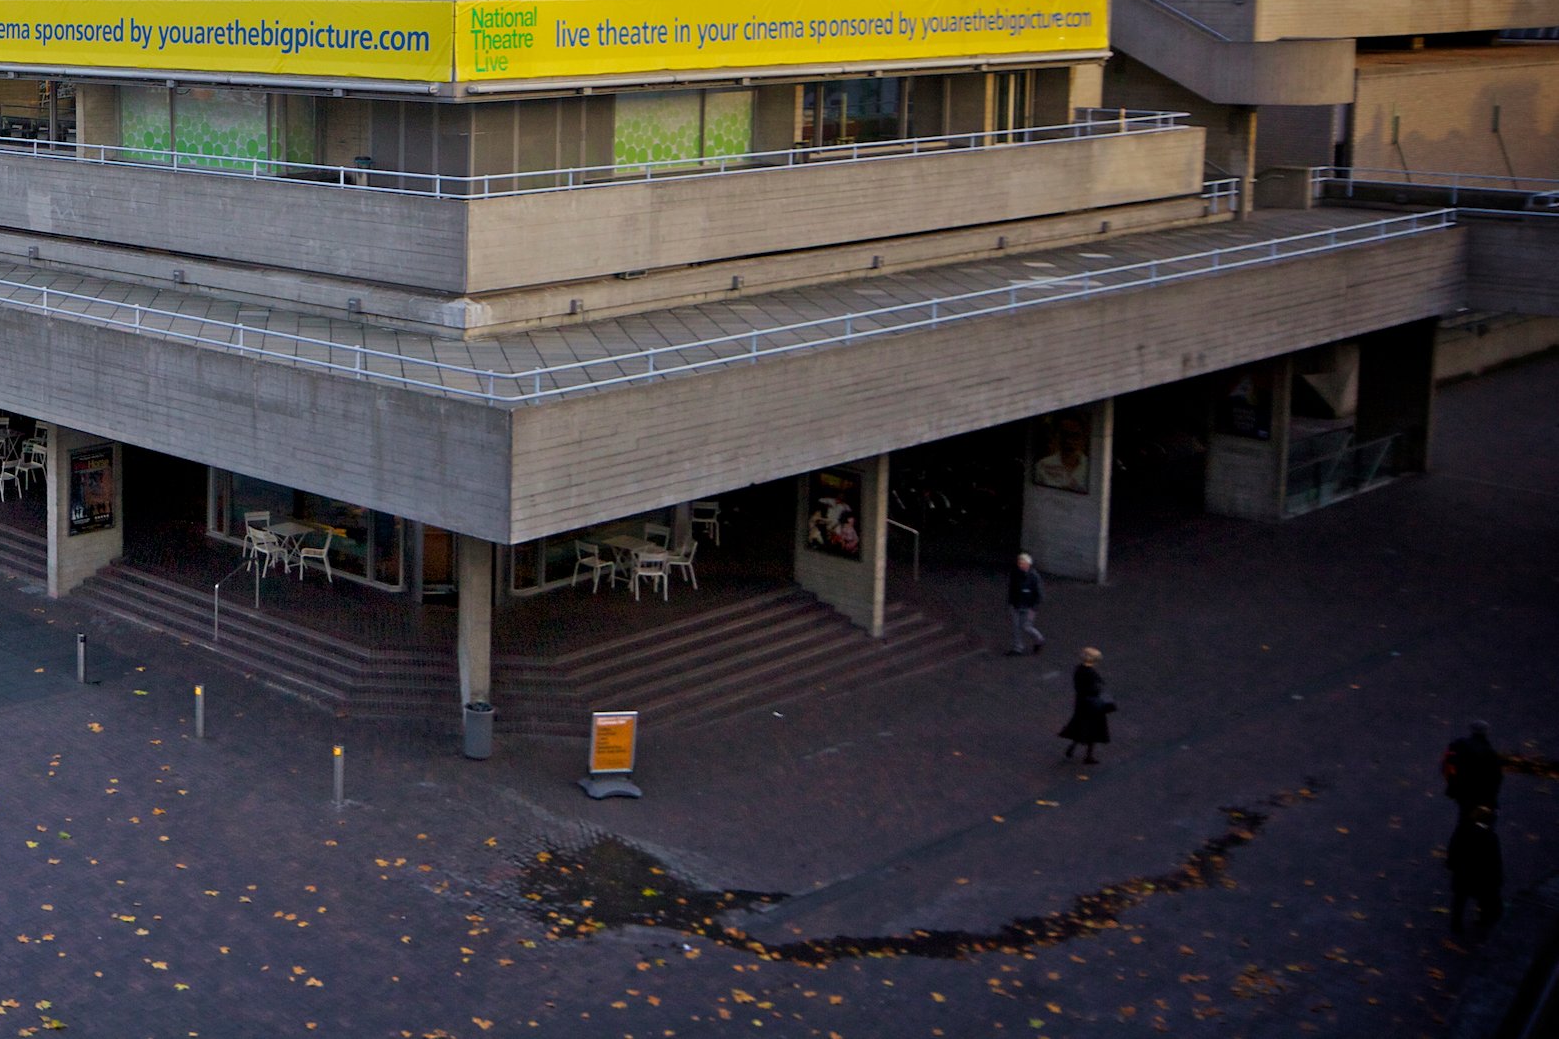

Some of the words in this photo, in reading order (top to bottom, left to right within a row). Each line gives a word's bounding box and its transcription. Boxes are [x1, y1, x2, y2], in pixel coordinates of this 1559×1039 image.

[471, 6, 538, 30] National
[556, 19, 590, 48] live
[596, 18, 668, 47] theatre
[675, 17, 691, 43] in
[697, 21, 738, 49] your
[743, 16, 805, 41] cinema
[808, 11, 894, 43] sponsored
[898, 11, 917, 40] by
[921, 8, 1092, 40] youarethebigpicture.com
[34, 18, 124, 46] sponsored
[130, 17, 152, 49] by
[158, 19, 430, 54] youarethebigpicture.com
[470, 29, 534, 51] Theatre
[474, 50, 508, 72] Live
